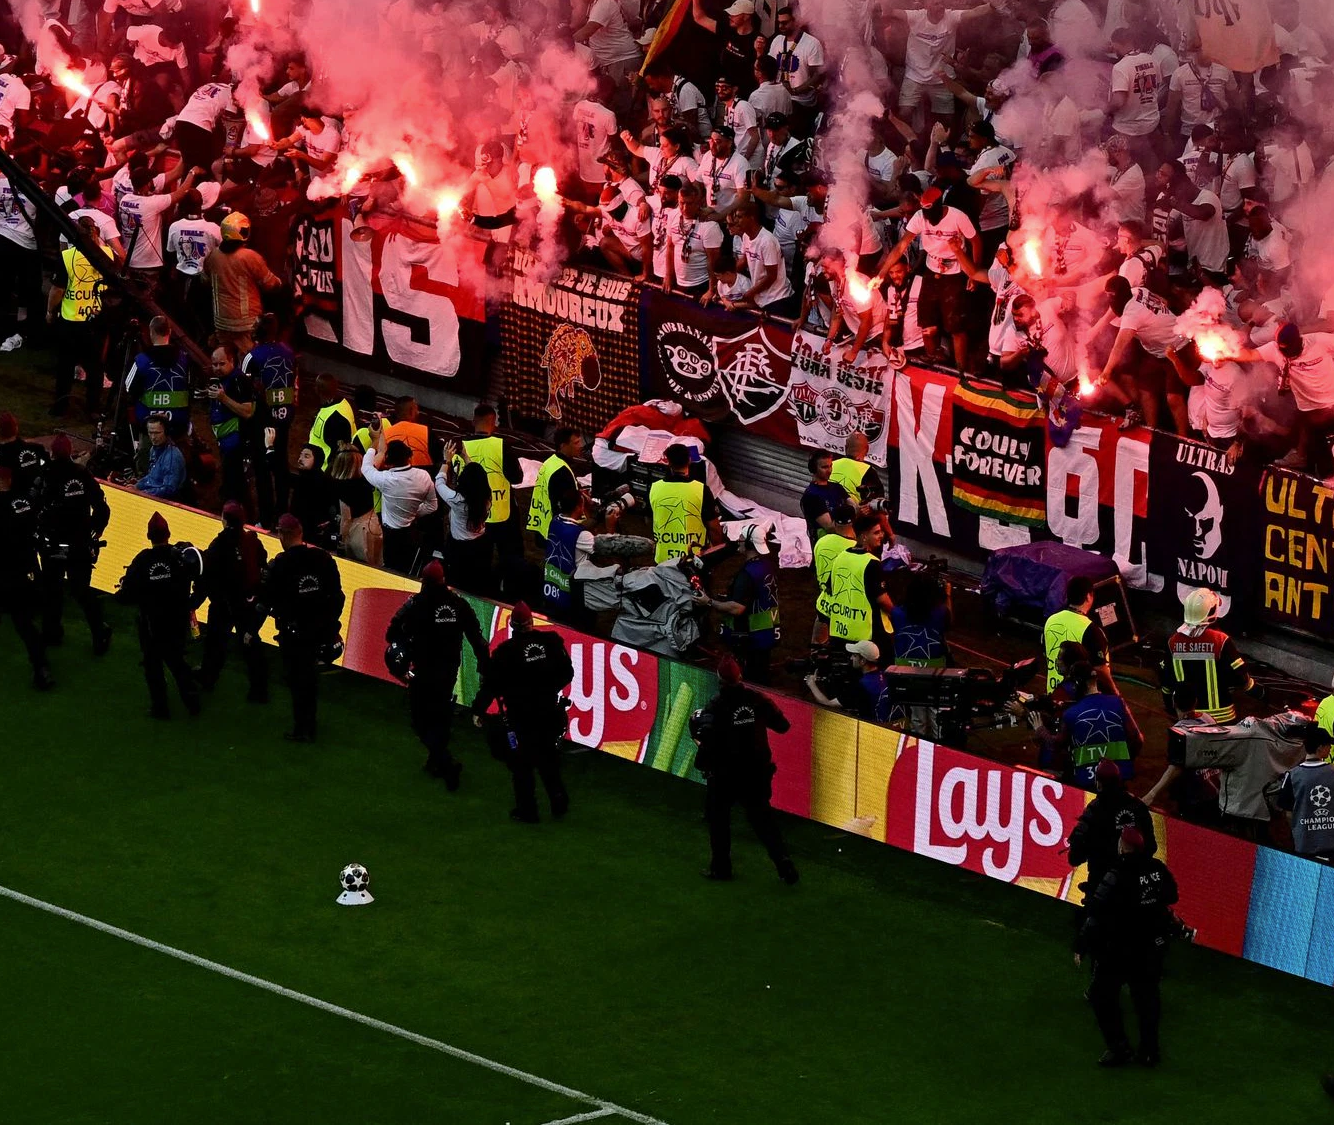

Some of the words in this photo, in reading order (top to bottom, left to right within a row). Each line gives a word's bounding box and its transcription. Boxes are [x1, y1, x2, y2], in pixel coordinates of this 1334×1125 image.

[179, 229, 205, 238] FINALE
[576, 274, 595, 295] JE
[596, 279, 632, 302] SUIS
[512, 273, 625, 334] AMOUREUX
[78, 305, 99, 318] 403
[152, 394, 171, 406] HB
[273, 390, 286, 403] HB
[959, 426, 1032, 461] COULY
[953, 444, 1043, 486] FOREVER
[1175, 442, 1236, 476] ULTRAS
[1173, 642, 1187, 653] FIRE
[1189, 642, 1215, 653] SAFETY
[1085, 745, 1106, 759] TV
